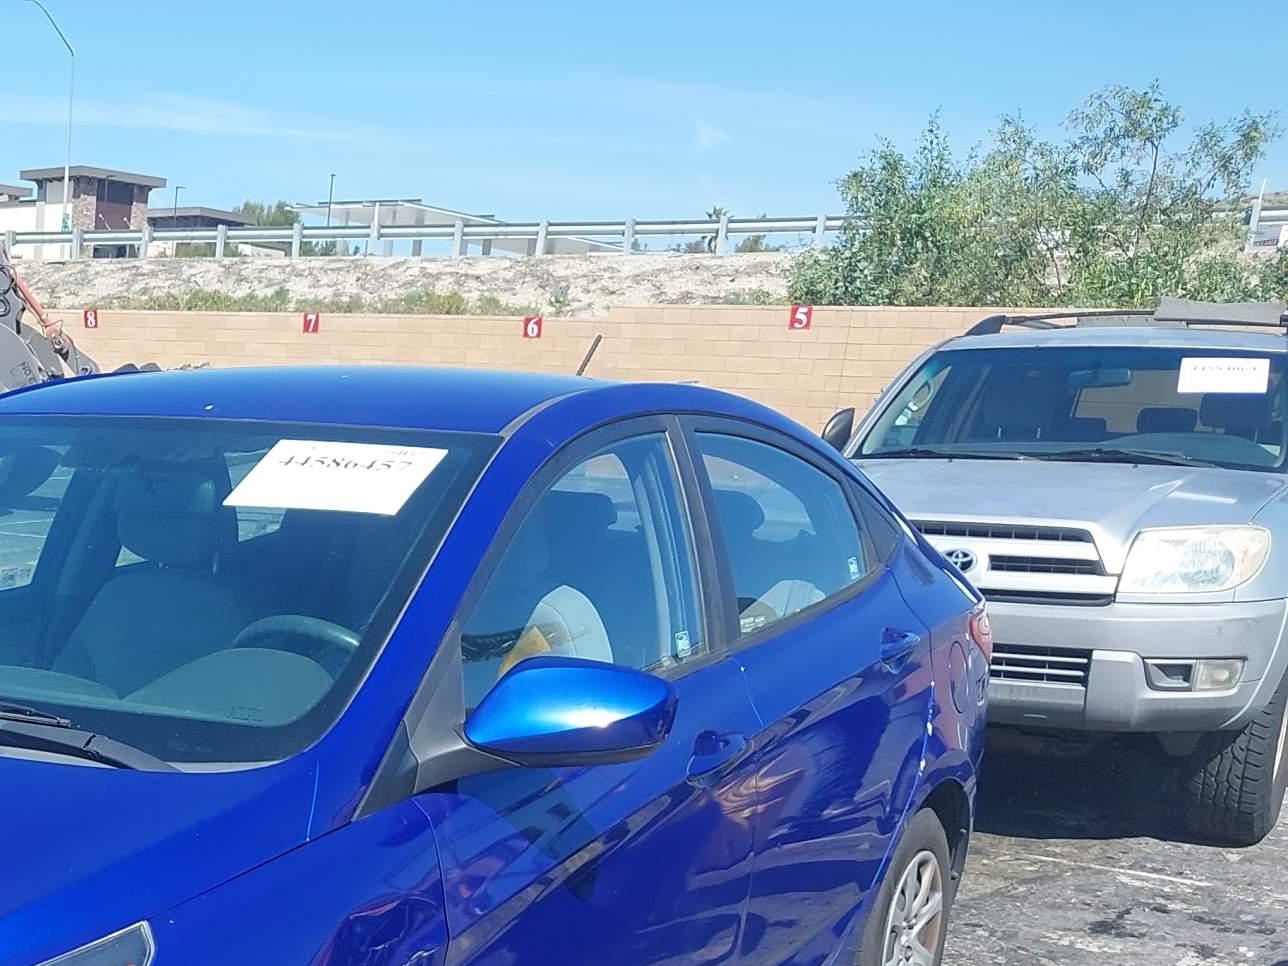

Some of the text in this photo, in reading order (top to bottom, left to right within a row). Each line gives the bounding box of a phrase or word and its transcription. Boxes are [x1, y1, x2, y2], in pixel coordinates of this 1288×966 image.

[87, 311, 95, 328] 8
[307, 314, 316, 332] 7
[794, 307, 808, 328] 5
[527, 318, 538, 337] 6
